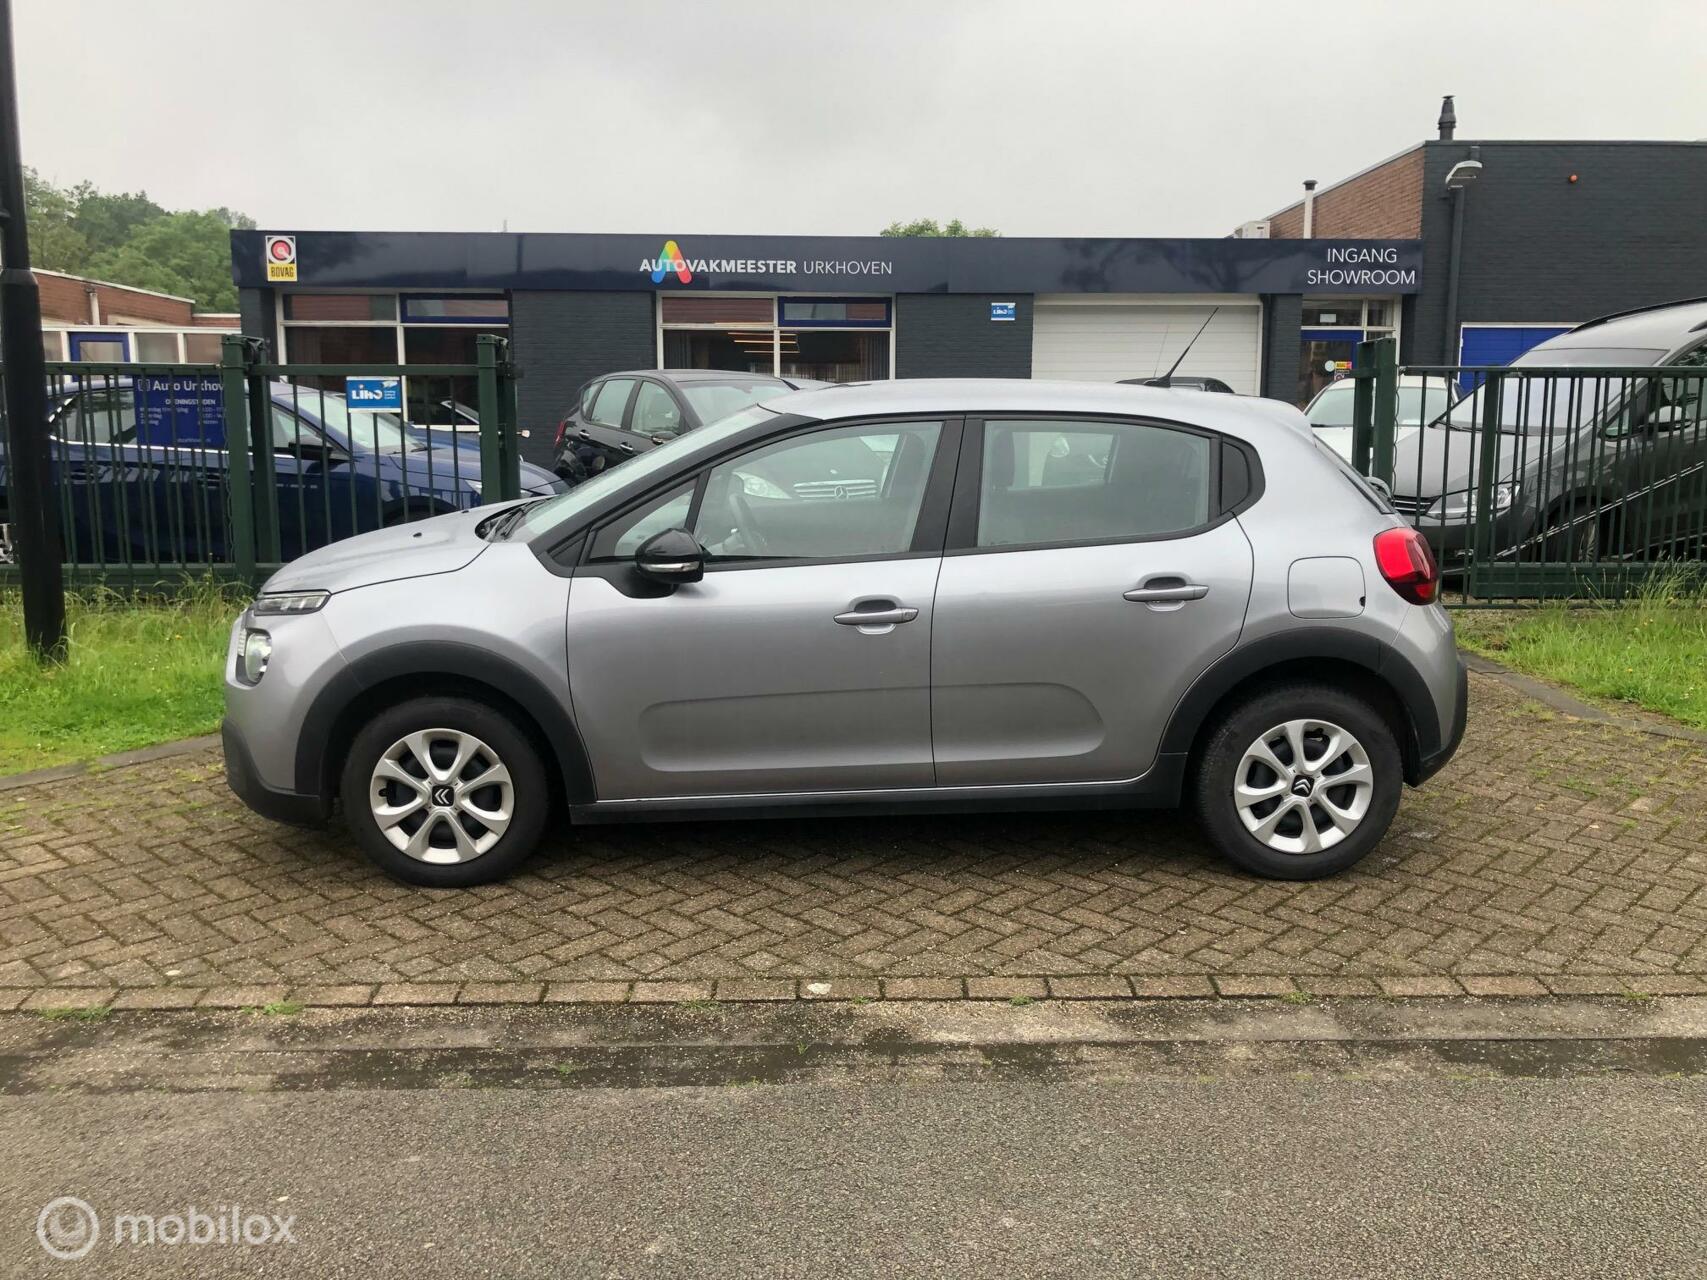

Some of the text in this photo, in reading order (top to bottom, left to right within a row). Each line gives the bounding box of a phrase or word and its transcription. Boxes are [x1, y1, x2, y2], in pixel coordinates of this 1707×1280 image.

[1327, 248, 1397, 263] INGANG
[270, 266, 294, 278] BOVAG
[639, 259, 892, 275] AUTOVAKMEESTER URKHOVEN
[1307, 269, 1416, 285] SHOWROOM
[153, 380, 181, 391] Auo
